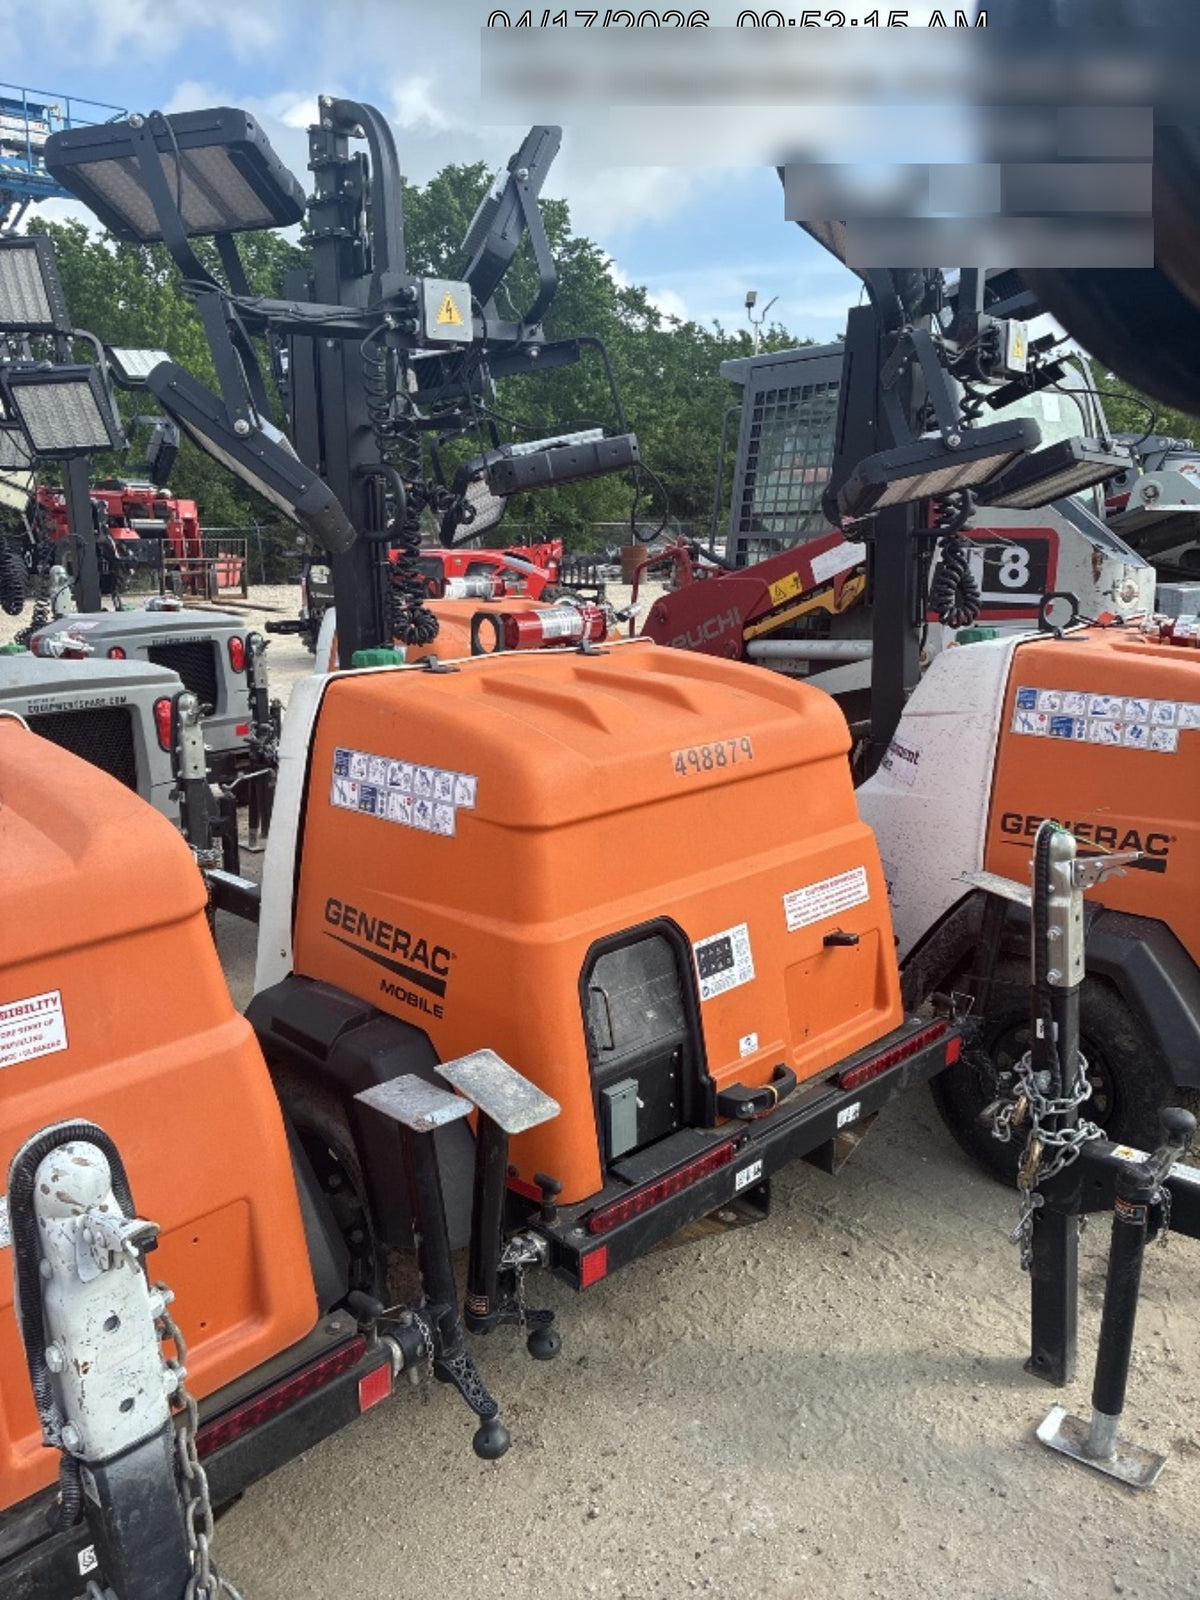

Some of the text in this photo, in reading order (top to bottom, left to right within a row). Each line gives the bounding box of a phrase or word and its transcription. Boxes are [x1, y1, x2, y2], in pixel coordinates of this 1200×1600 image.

[675, 737, 753, 775] 498879
[1001, 812, 1170, 855] GEERAC
[324, 896, 451, 977] GENERAC
[0, 996, 58, 1021] SIBILITY
[379, 979, 445, 1020] MOBILE
